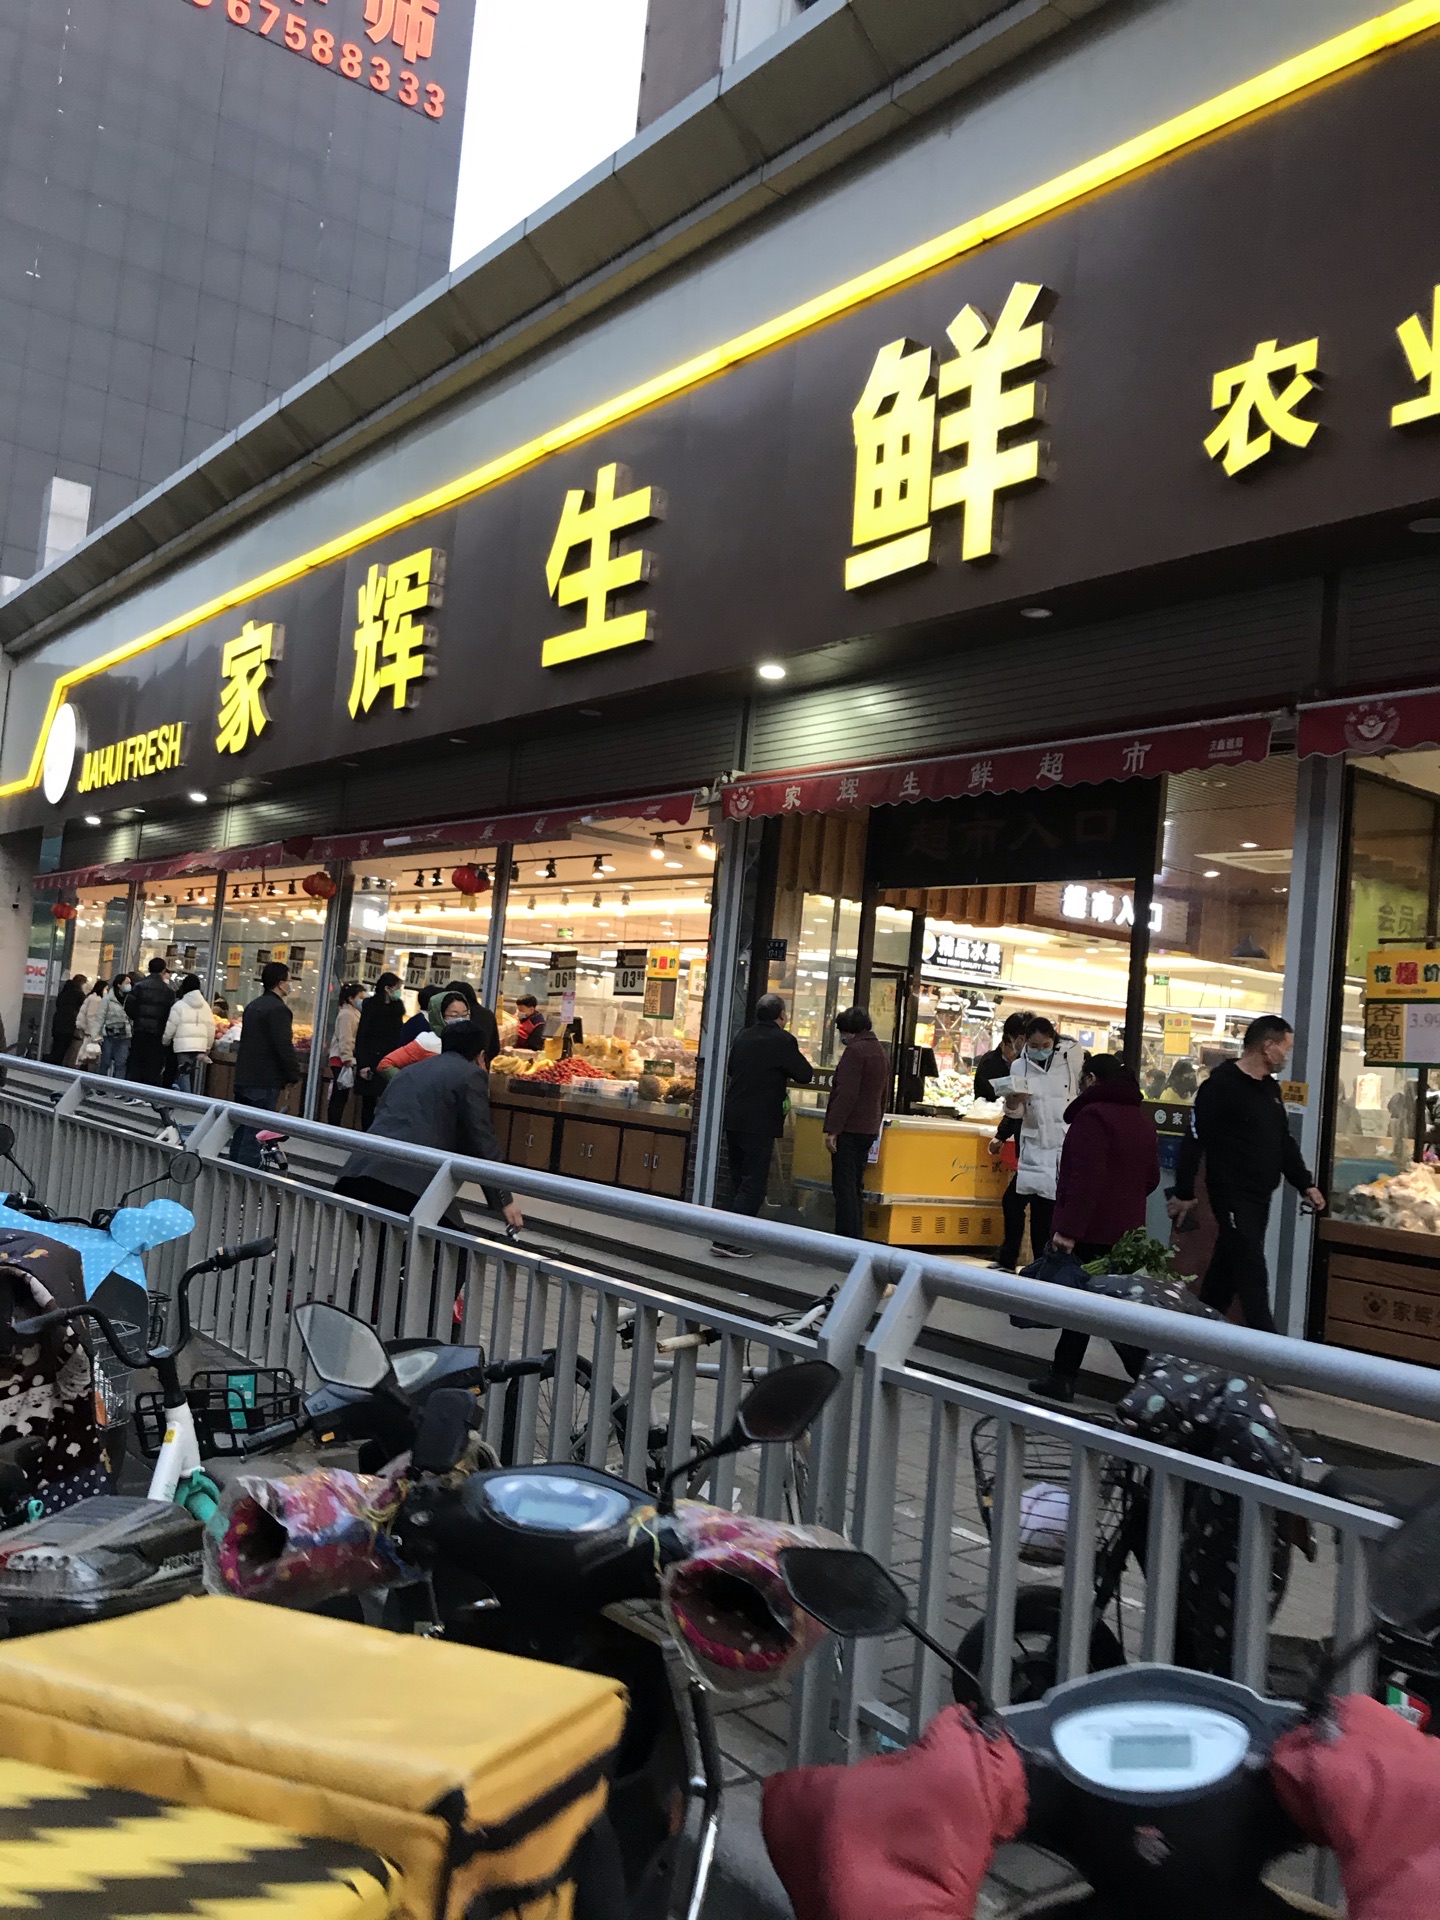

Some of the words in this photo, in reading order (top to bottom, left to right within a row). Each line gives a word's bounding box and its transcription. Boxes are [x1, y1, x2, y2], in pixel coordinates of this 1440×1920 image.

[192, 0, 446, 118] 67588333
[77, 740, 126, 794] JIAHUI
[123, 721, 182, 781] FRESH
[782, 741, 1152, 810] 家辉生鲜超市
